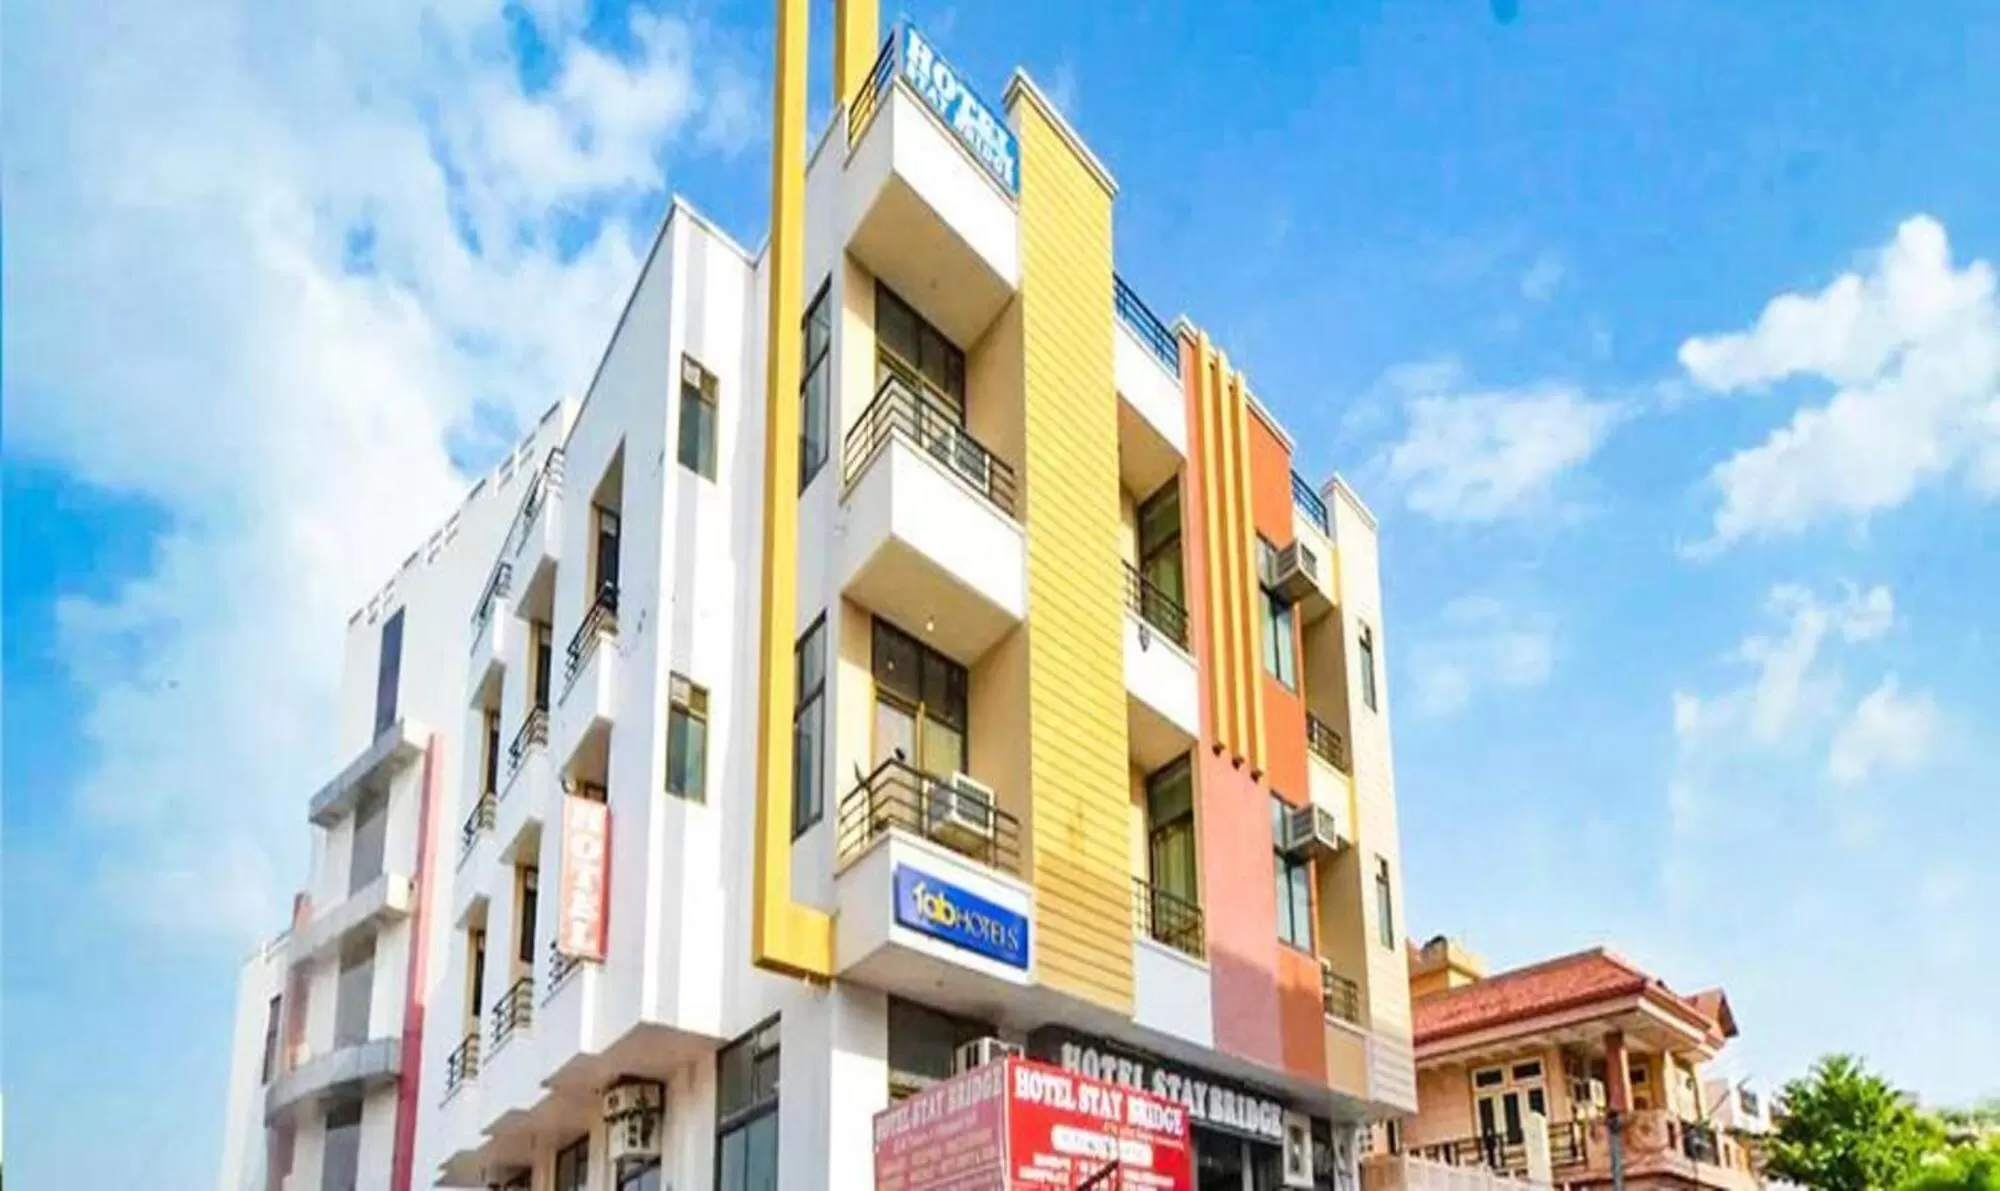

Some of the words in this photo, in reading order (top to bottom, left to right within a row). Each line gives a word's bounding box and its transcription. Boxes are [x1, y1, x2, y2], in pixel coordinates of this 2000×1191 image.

[908, 28, 1012, 152] HOTEL
[568, 800, 605, 950] HOTEL
[1015, 1065, 1076, 1111] HOTEL
[1078, 1082, 1123, 1122] STAY
[1126, 1094, 1184, 1137] BRIDGE
[1061, 1042, 1145, 1090] HOTEL
